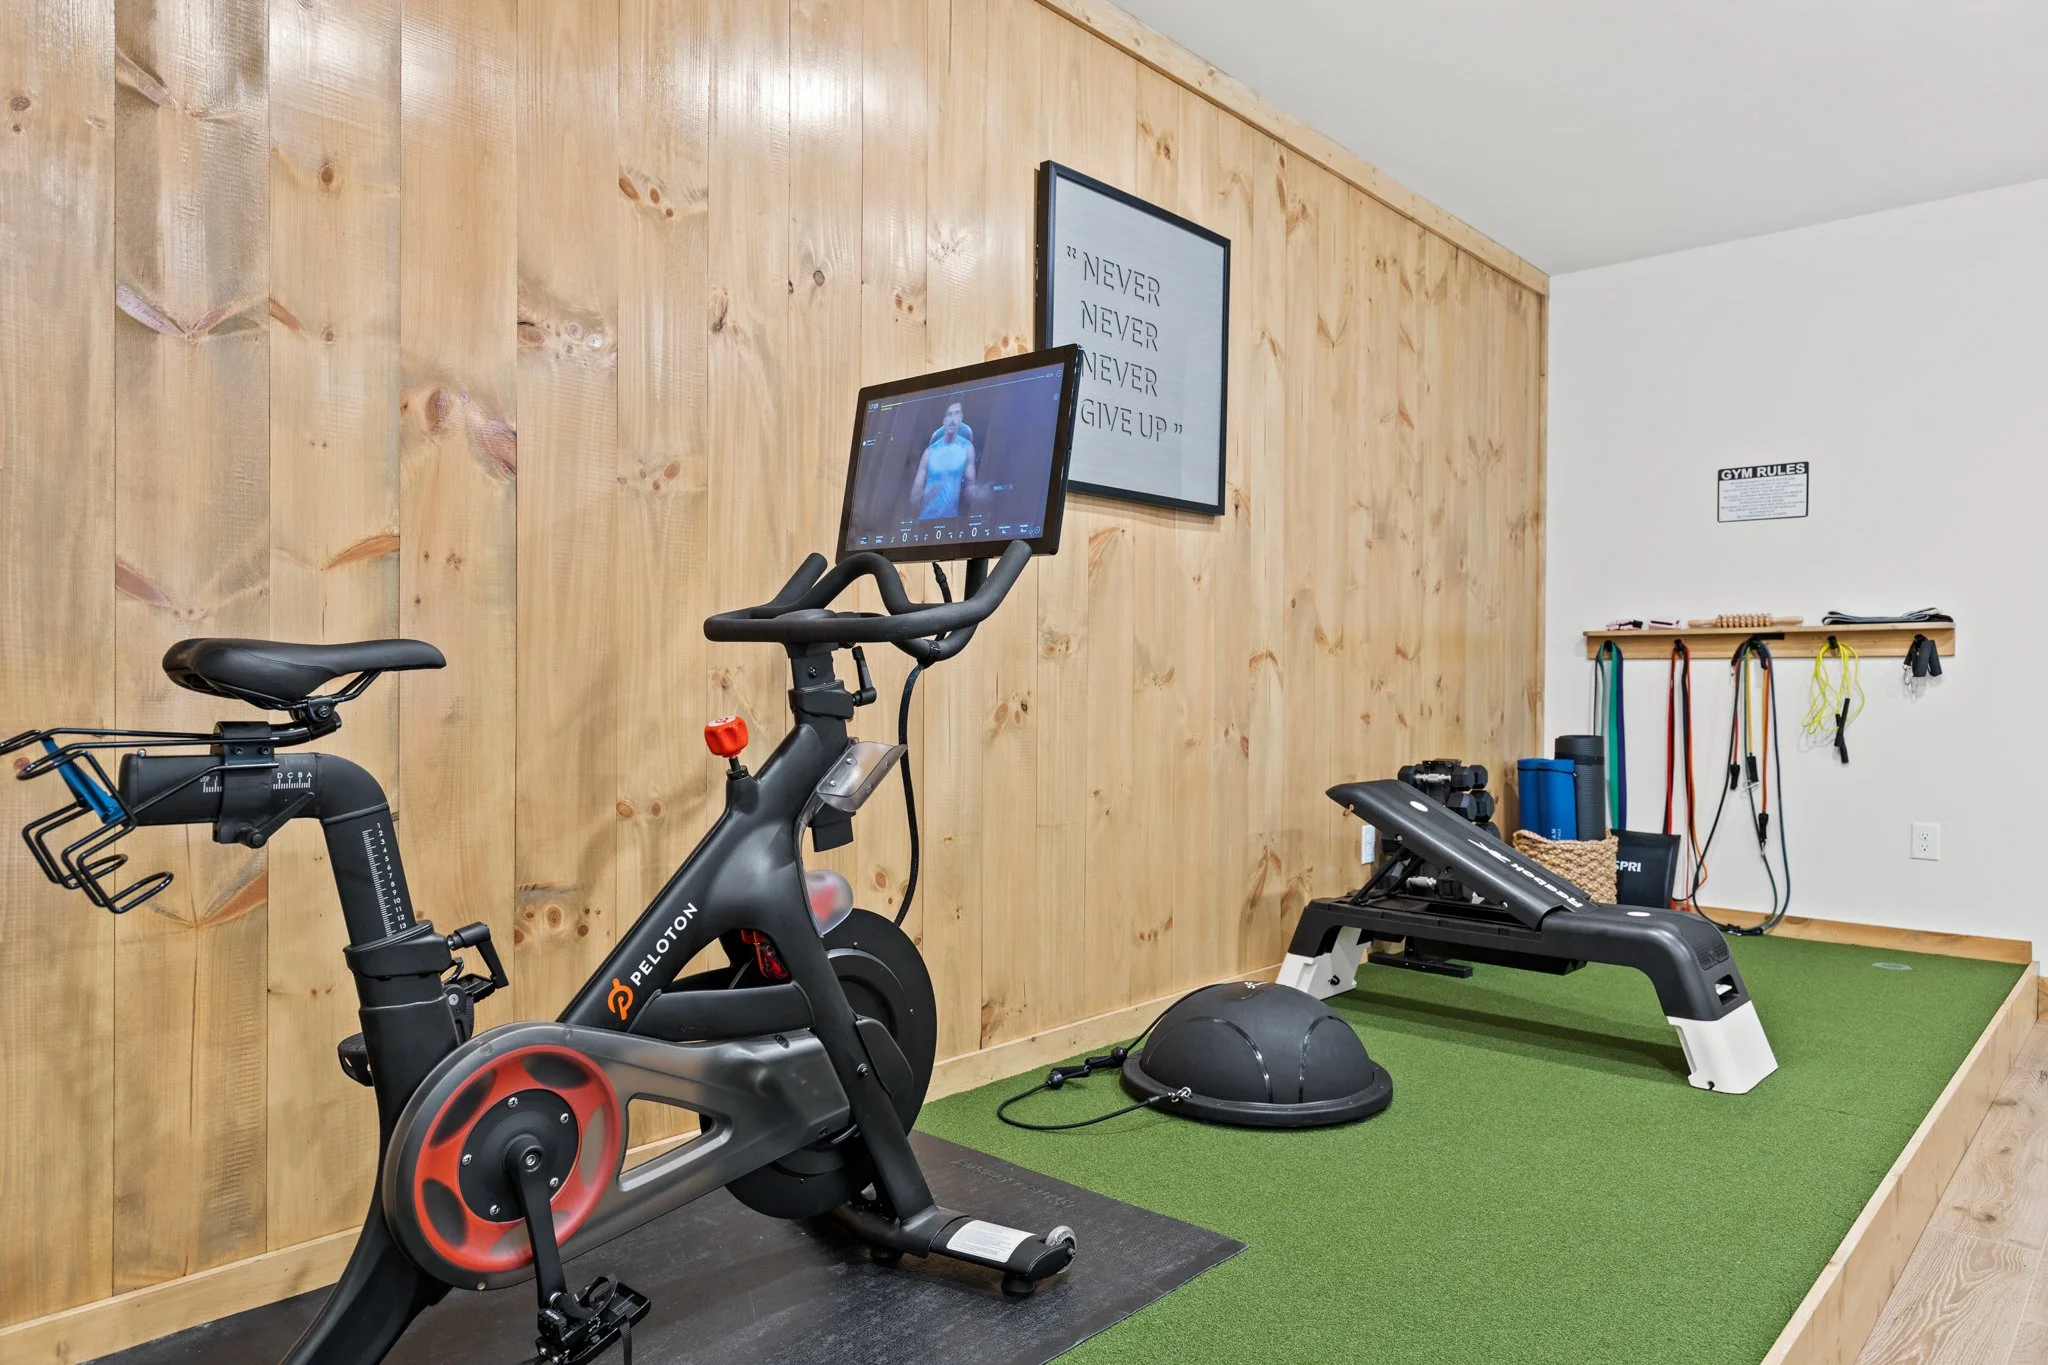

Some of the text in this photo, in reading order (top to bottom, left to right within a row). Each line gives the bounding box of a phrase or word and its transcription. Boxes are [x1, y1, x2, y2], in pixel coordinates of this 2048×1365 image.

[1081, 300, 1158, 352] NEVER
[1081, 350, 1158, 397] NEVER
[1081, 399, 1132, 436] GIVE
[1721, 463, 1805, 480] GYM RULES
[1510, 863, 1584, 908] Reebok
[629, 902, 698, 986] PELOTON
